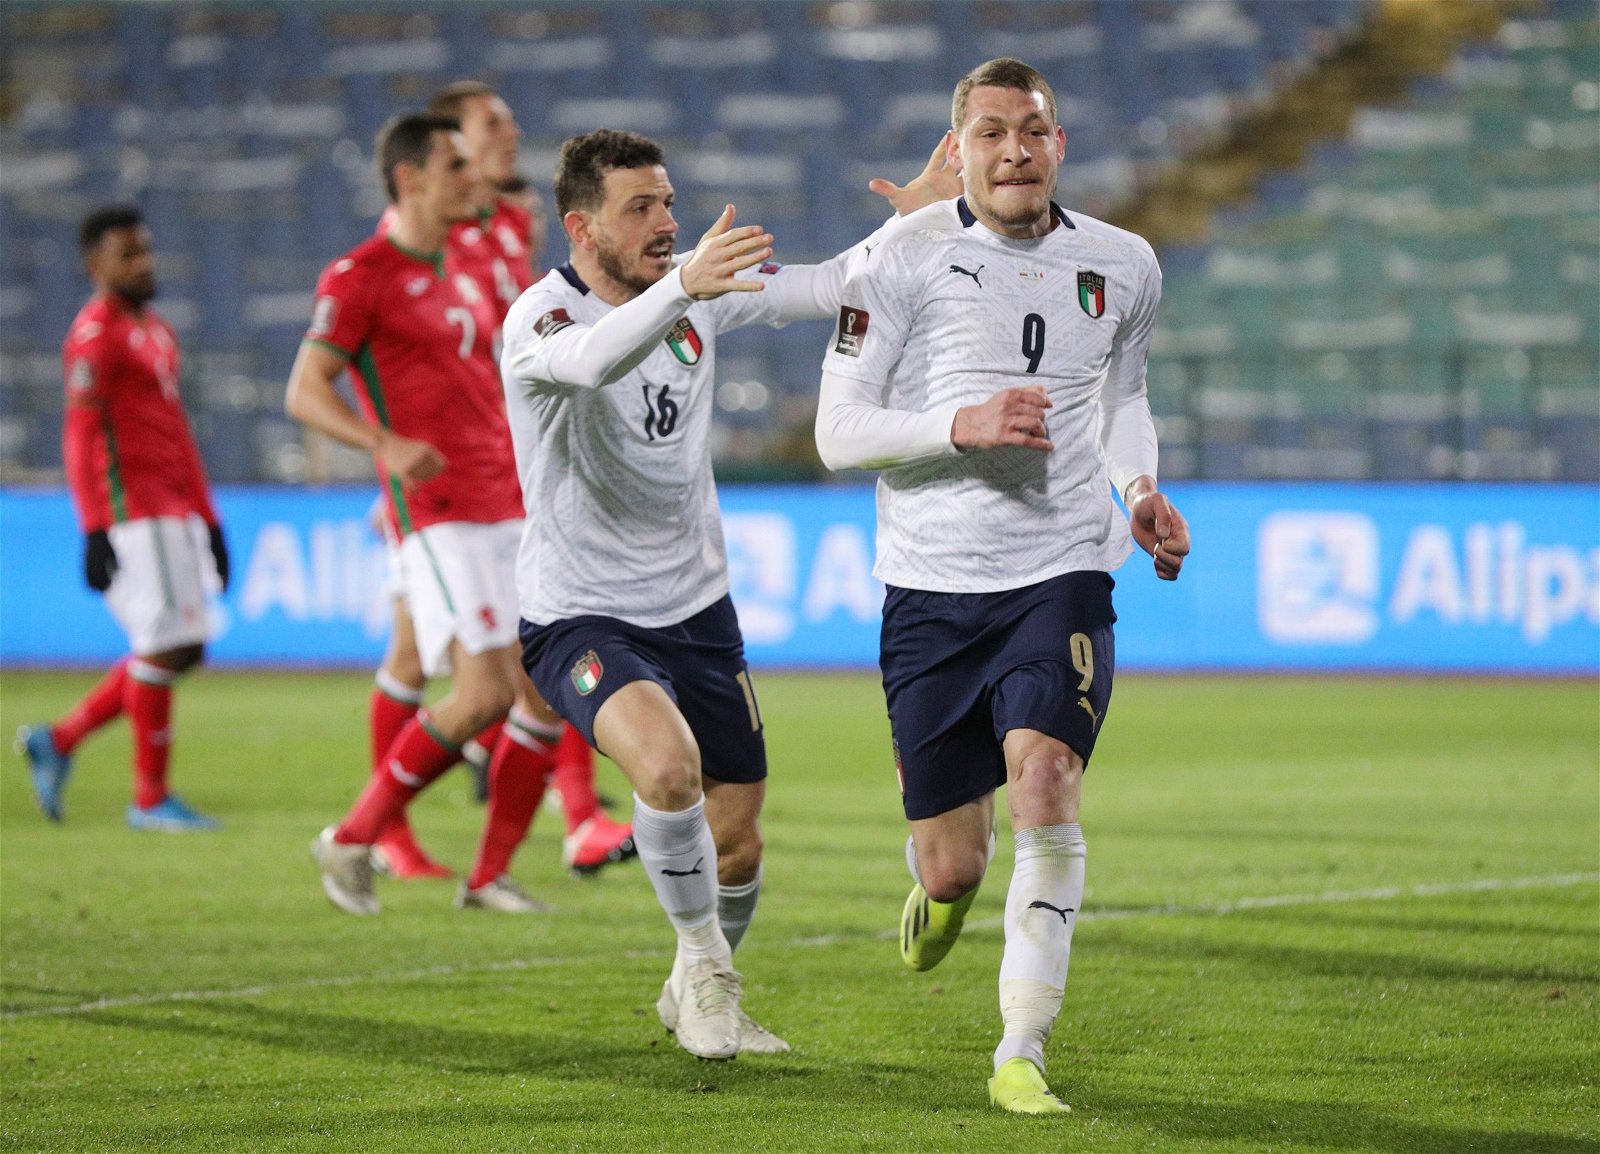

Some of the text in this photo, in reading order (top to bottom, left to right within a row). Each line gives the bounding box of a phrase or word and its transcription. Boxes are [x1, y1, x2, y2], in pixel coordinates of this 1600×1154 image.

[1079, 274, 1104, 287] ITALIA
[445, 308, 476, 359] 7
[1022, 312, 1045, 374] 9
[642, 384, 678, 441] 16
[1388, 519, 1600, 646] Alip
[1069, 632, 1094, 692] 9
